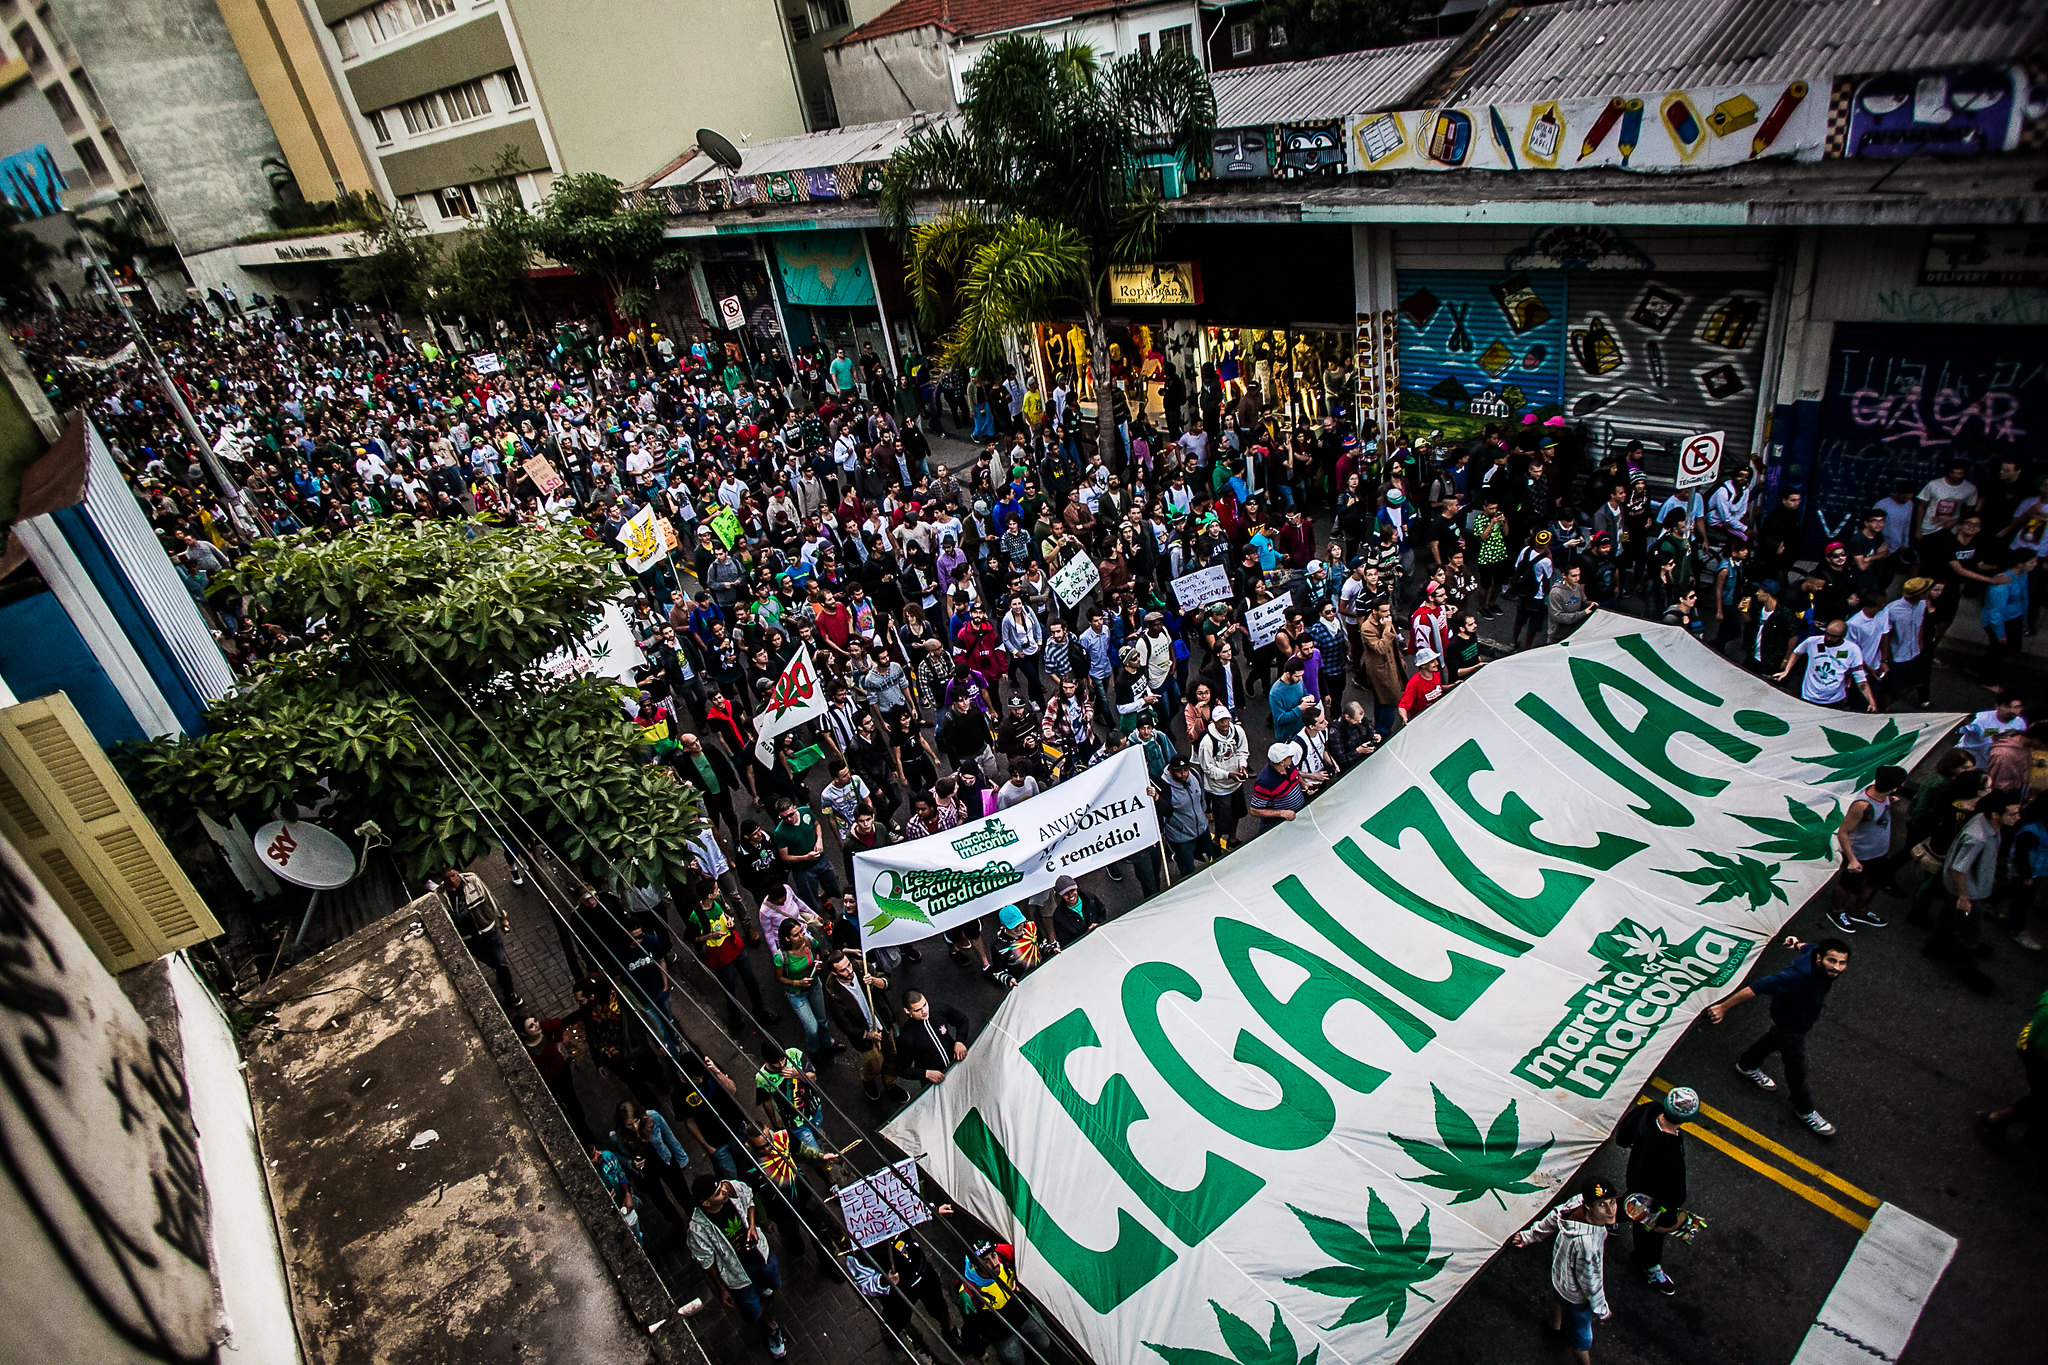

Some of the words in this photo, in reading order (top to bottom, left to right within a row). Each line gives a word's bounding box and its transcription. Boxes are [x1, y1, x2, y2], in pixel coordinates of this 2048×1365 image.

[1693, 442, 1710, 468] E
[540, 476, 560, 493] LSD
[1071, 586, 1086, 600] BIG
[1086, 570, 1099, 587] MAC
[267, 825, 298, 867] SKY
[953, 830, 991, 850] marcha
[959, 829, 1017, 859] maconha
[1045, 854, 1056, 873] é
[1060, 822, 1141, 867] remédio!
[1734, 942, 1751, 960] 2012
[1524, 970, 1648, 1083] marcha
[1640, 961, 1665, 974] da
[1565, 930, 1739, 1092] maconha
[1009, 740, 1644, 1314] LEGALIZE
[842, 1183, 866, 1203] EU
[844, 1176, 913, 1214] TENHO
[849, 1207, 883, 1230] MAS
[852, 1216, 894, 1241] ONDE
